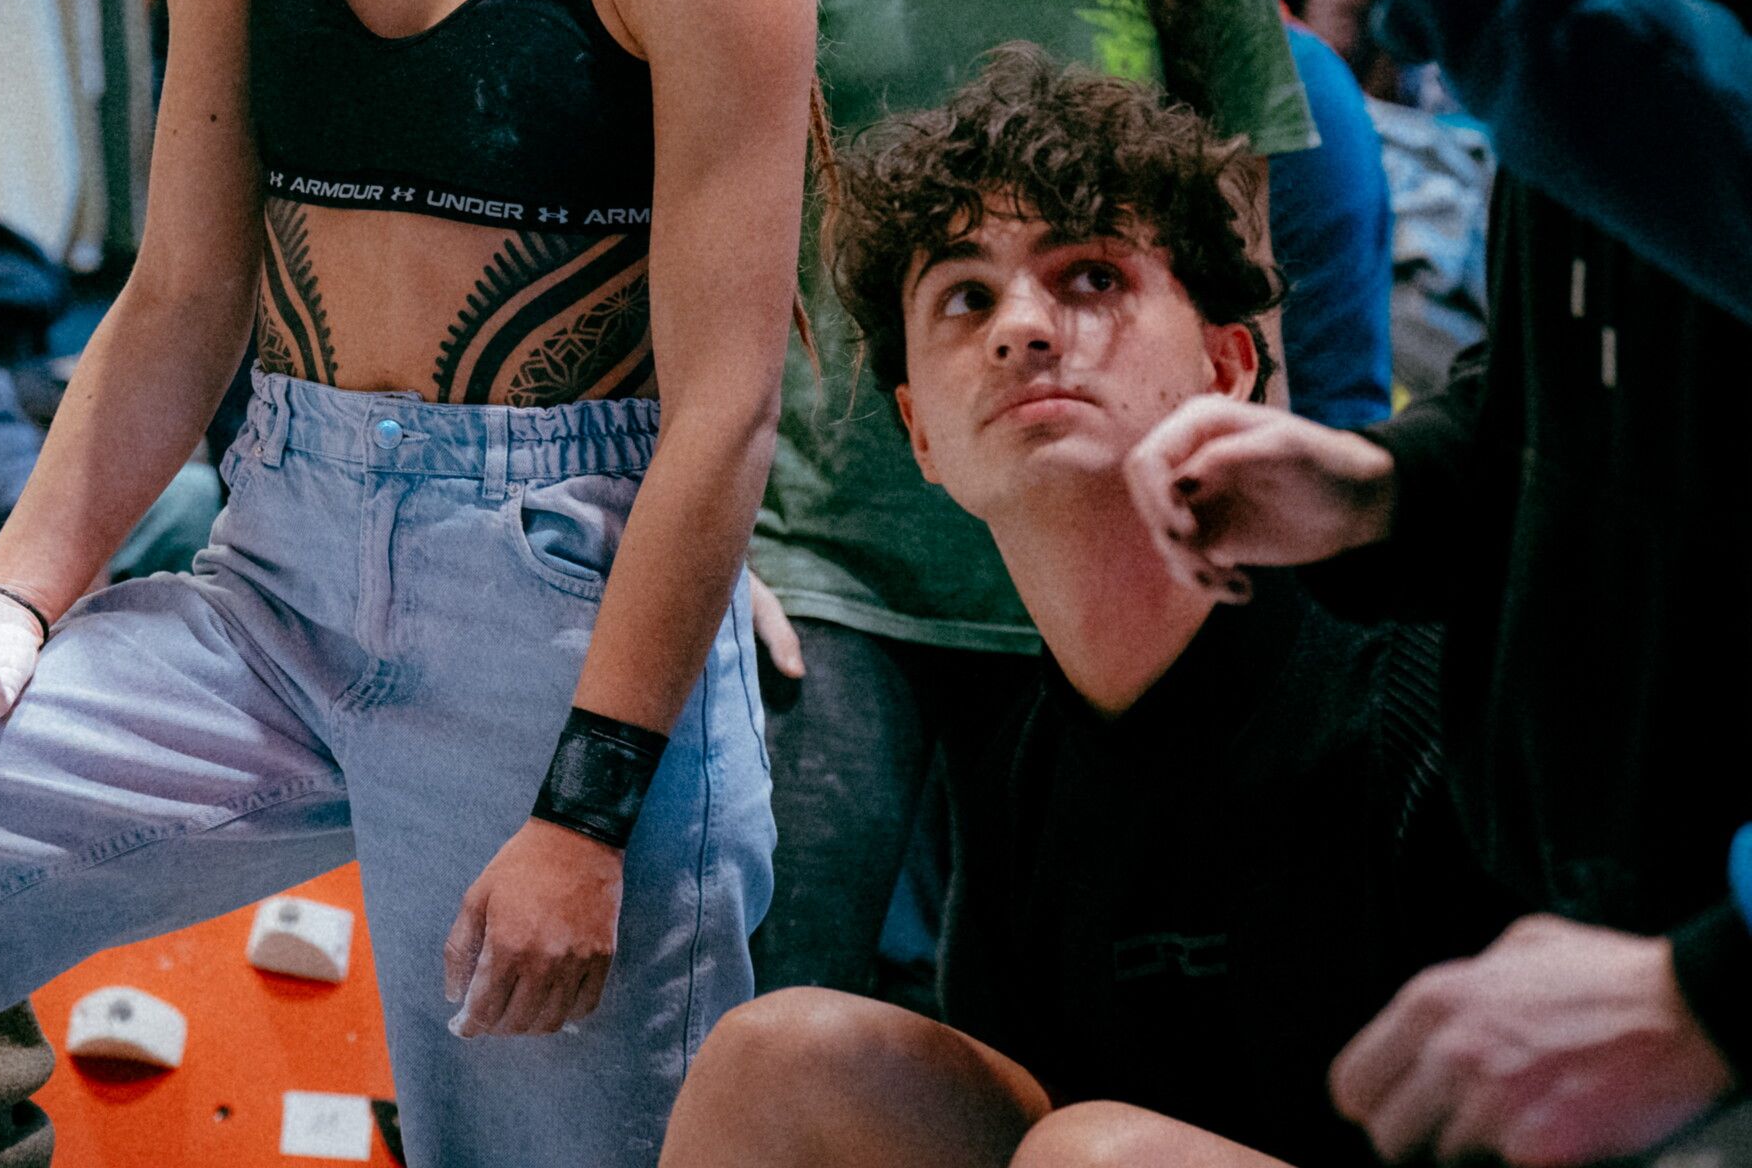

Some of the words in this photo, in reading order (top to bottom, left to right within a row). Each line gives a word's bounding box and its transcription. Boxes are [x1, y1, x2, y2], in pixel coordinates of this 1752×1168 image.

[289, 175, 384, 201] ARMOUR
[426, 189, 523, 221] UNDER
[583, 207, 651, 226] ARM
